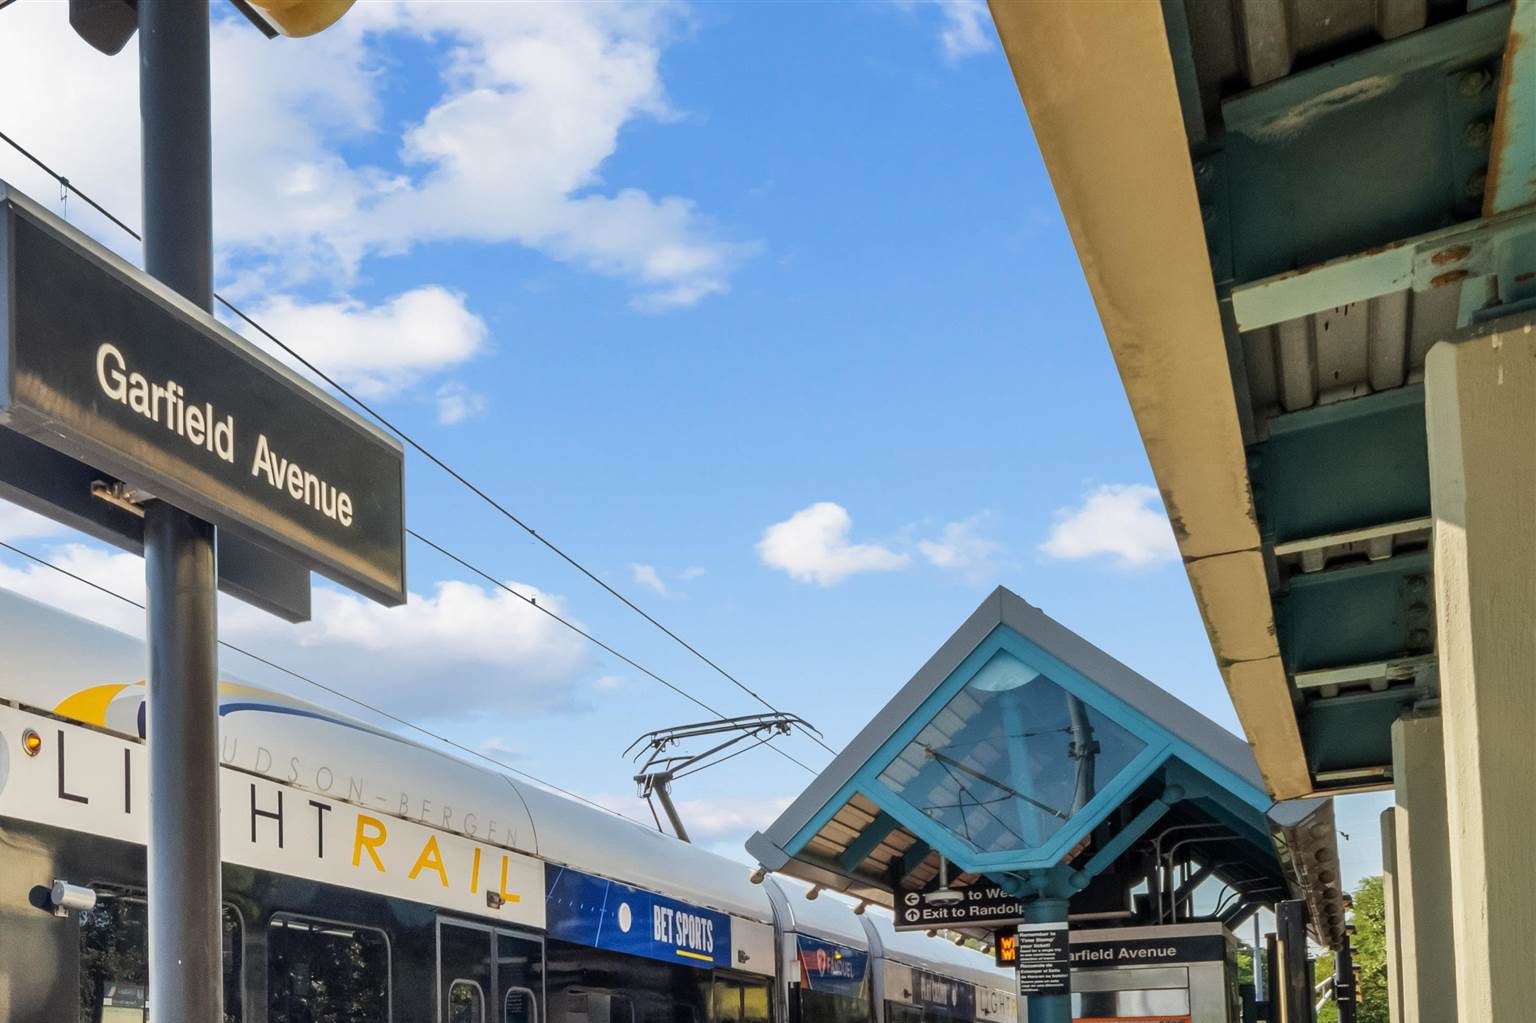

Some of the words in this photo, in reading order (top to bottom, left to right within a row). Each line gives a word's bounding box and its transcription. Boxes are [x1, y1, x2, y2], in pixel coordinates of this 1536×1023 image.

[96, 343, 234, 463] Garfield
[251, 433, 353, 527] Avenue
[221, 735, 518, 847] UDSON-BERGEN
[968, 889, 982, 901] to
[653, 904, 673, 944] BET
[675, 910, 714, 953] SPORTS
[922, 907, 949, 920] Exit
[951, 907, 965, 919] to
[1069, 947, 1114, 961] arfield
[1118, 946, 1177, 959] Avenue
